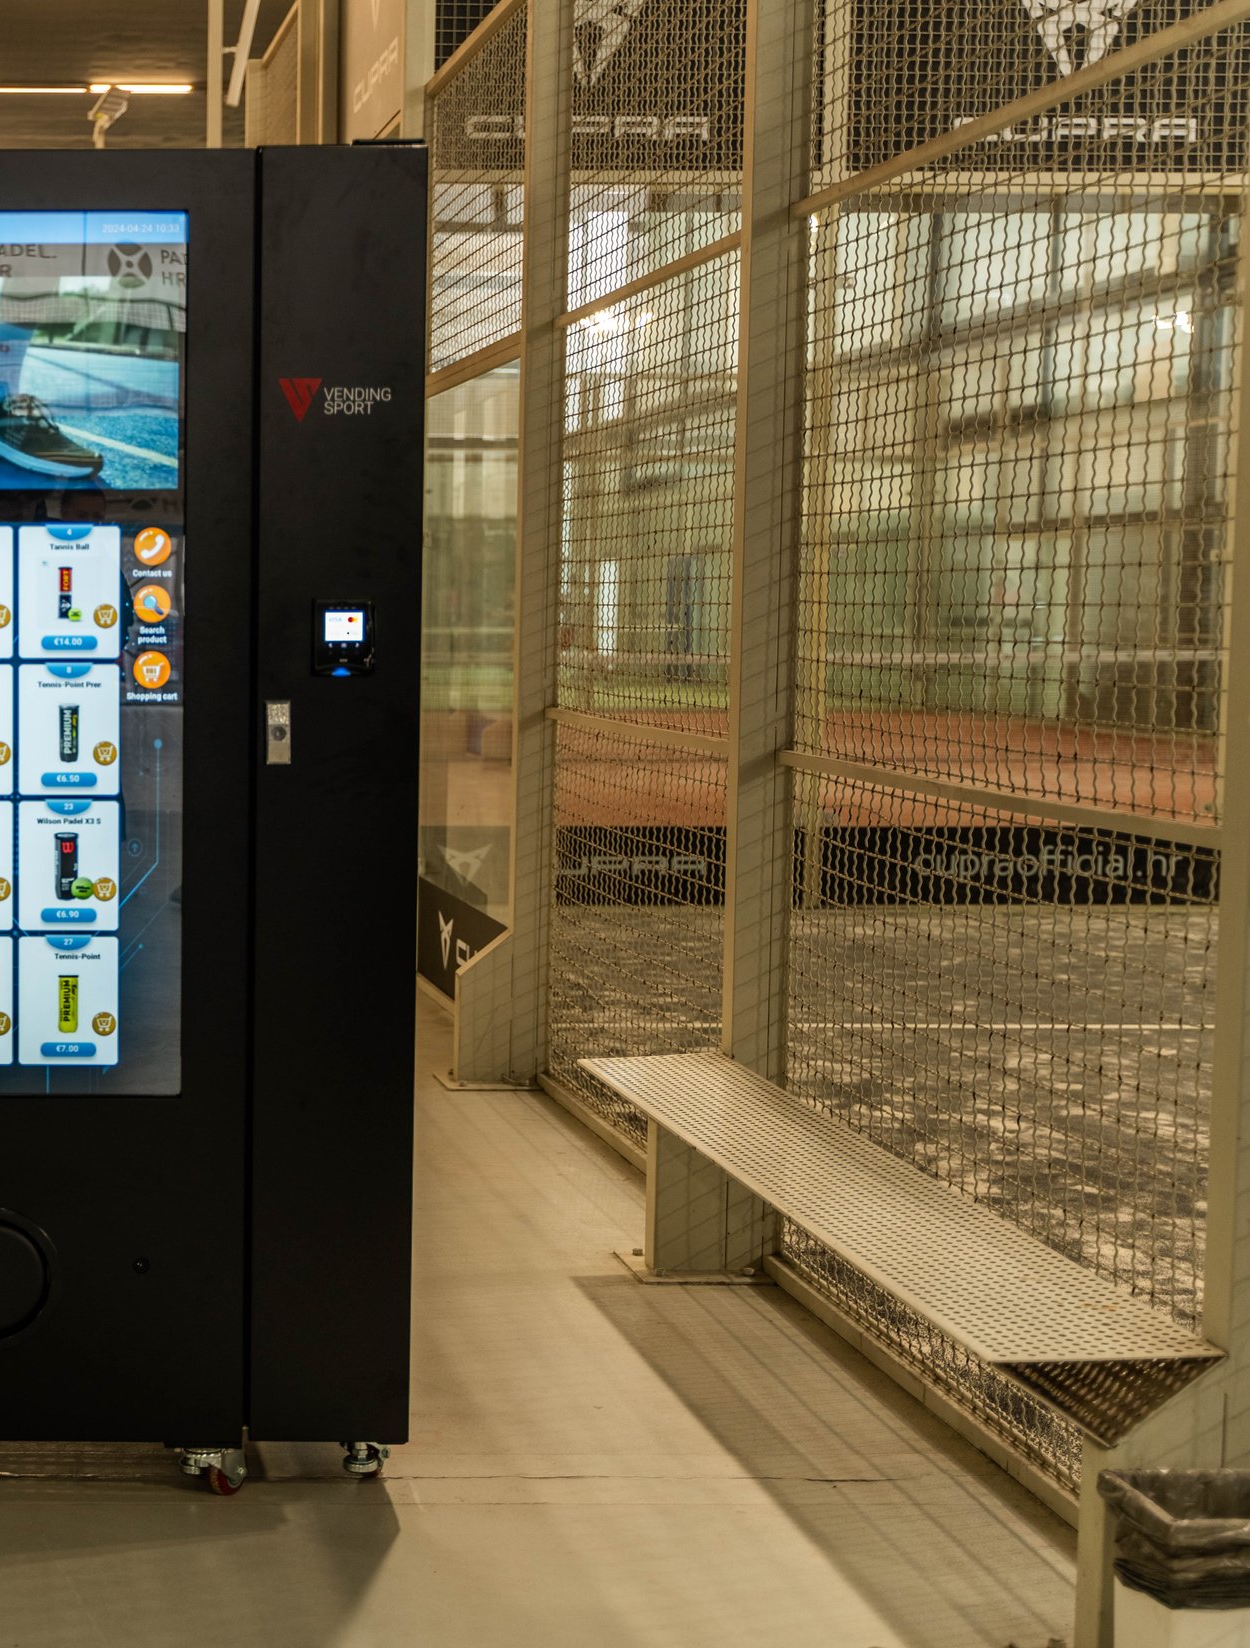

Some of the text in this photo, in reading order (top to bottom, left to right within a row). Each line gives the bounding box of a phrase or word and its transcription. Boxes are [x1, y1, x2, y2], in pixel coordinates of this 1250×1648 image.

[353, 36, 398, 113] CUPRA
[466, 115, 709, 141] CPRA
[324, 387, 391, 402] VENDING
[324, 401, 374, 415] SPORT
[132, 569, 173, 578] Contact us
[139, 626, 165, 634] Search
[54, 638, 82, 646] €14.00
[137, 635, 167, 645] product
[126, 692, 178, 702] Shopping cart
[63, 709, 72, 754] PREMIUM
[56, 775, 80, 783] €6.50
[56, 910, 79, 918] €6.90
[63, 979, 71, 1022] PREMIUM
[56, 1044, 79, 1052] €7.00
